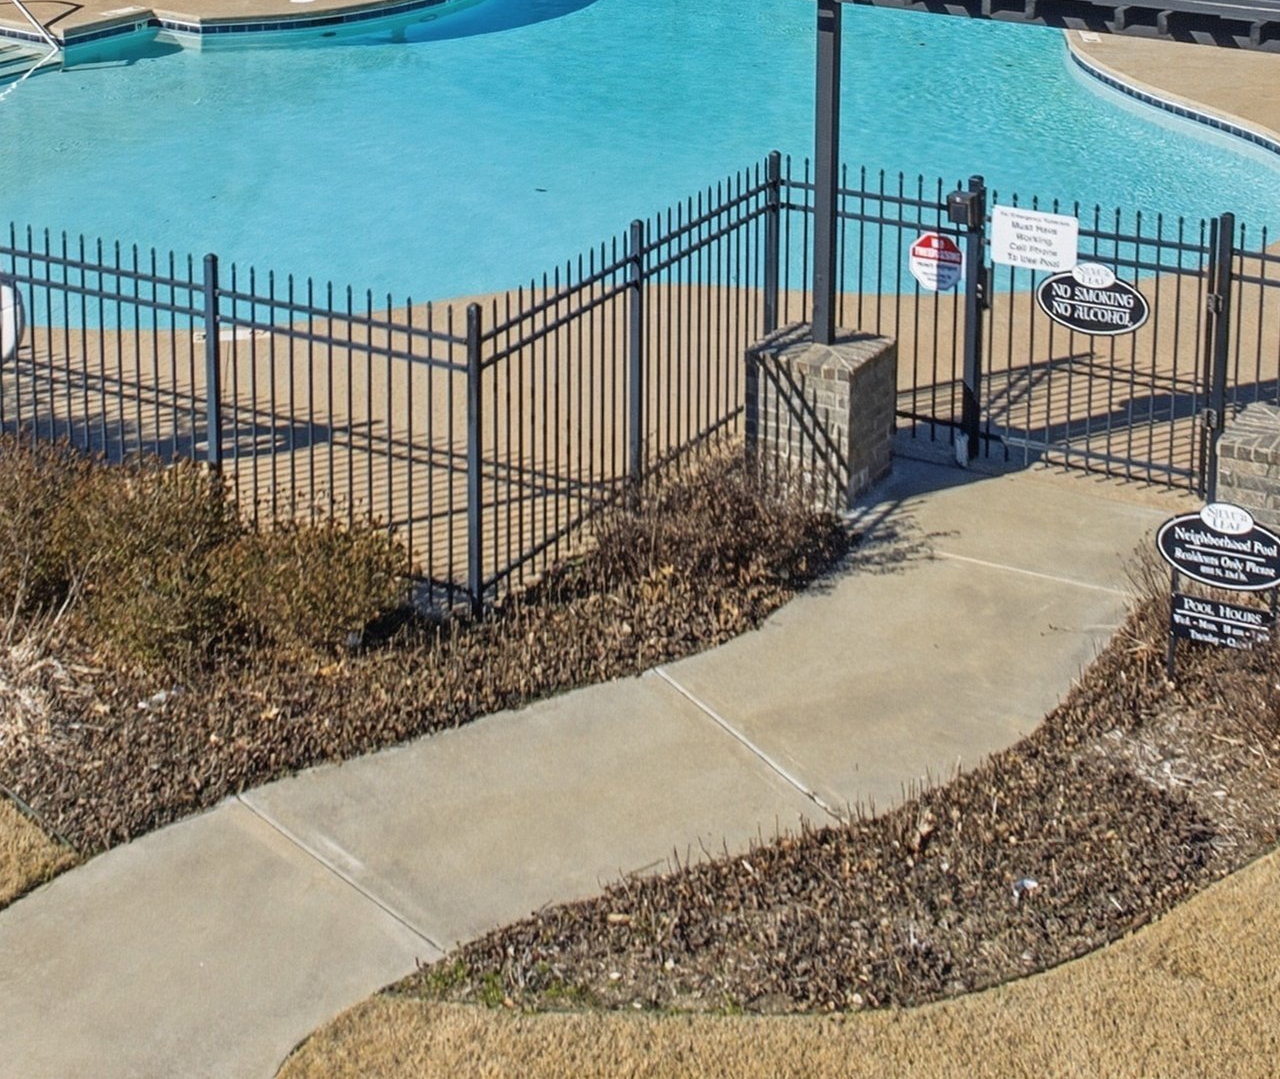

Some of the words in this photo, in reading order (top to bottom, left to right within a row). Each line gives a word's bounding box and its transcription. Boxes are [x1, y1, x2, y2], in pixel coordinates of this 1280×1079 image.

[1011, 221, 1034, 231] Must
[1035, 225, 1058, 235] Have
[1015, 232, 1053, 247] Working
[1007, 252, 1018, 262] To
[1020, 255, 1038, 265] Use
[1039, 257, 1061, 269] Pool
[1009, 242, 1027, 253] Cell
[1028, 246, 1058, 257] Phone
[1051, 282, 1072, 299] NO
[1074, 286, 1135, 309] SMOKING
[1051, 300, 1072, 317] NO
[1074, 305, 1134, 328] ALCOHOL
[1174, 526, 1252, 553] Neighborhood
[1253, 540, 1279, 558] Pool
[1174, 547, 1219, 567] Residents
[1220, 557, 1245, 572] Only
[1245, 561, 1277, 578] Please
[1183, 597, 1216, 616] POOL
[1219, 605, 1262, 625] HOURS
